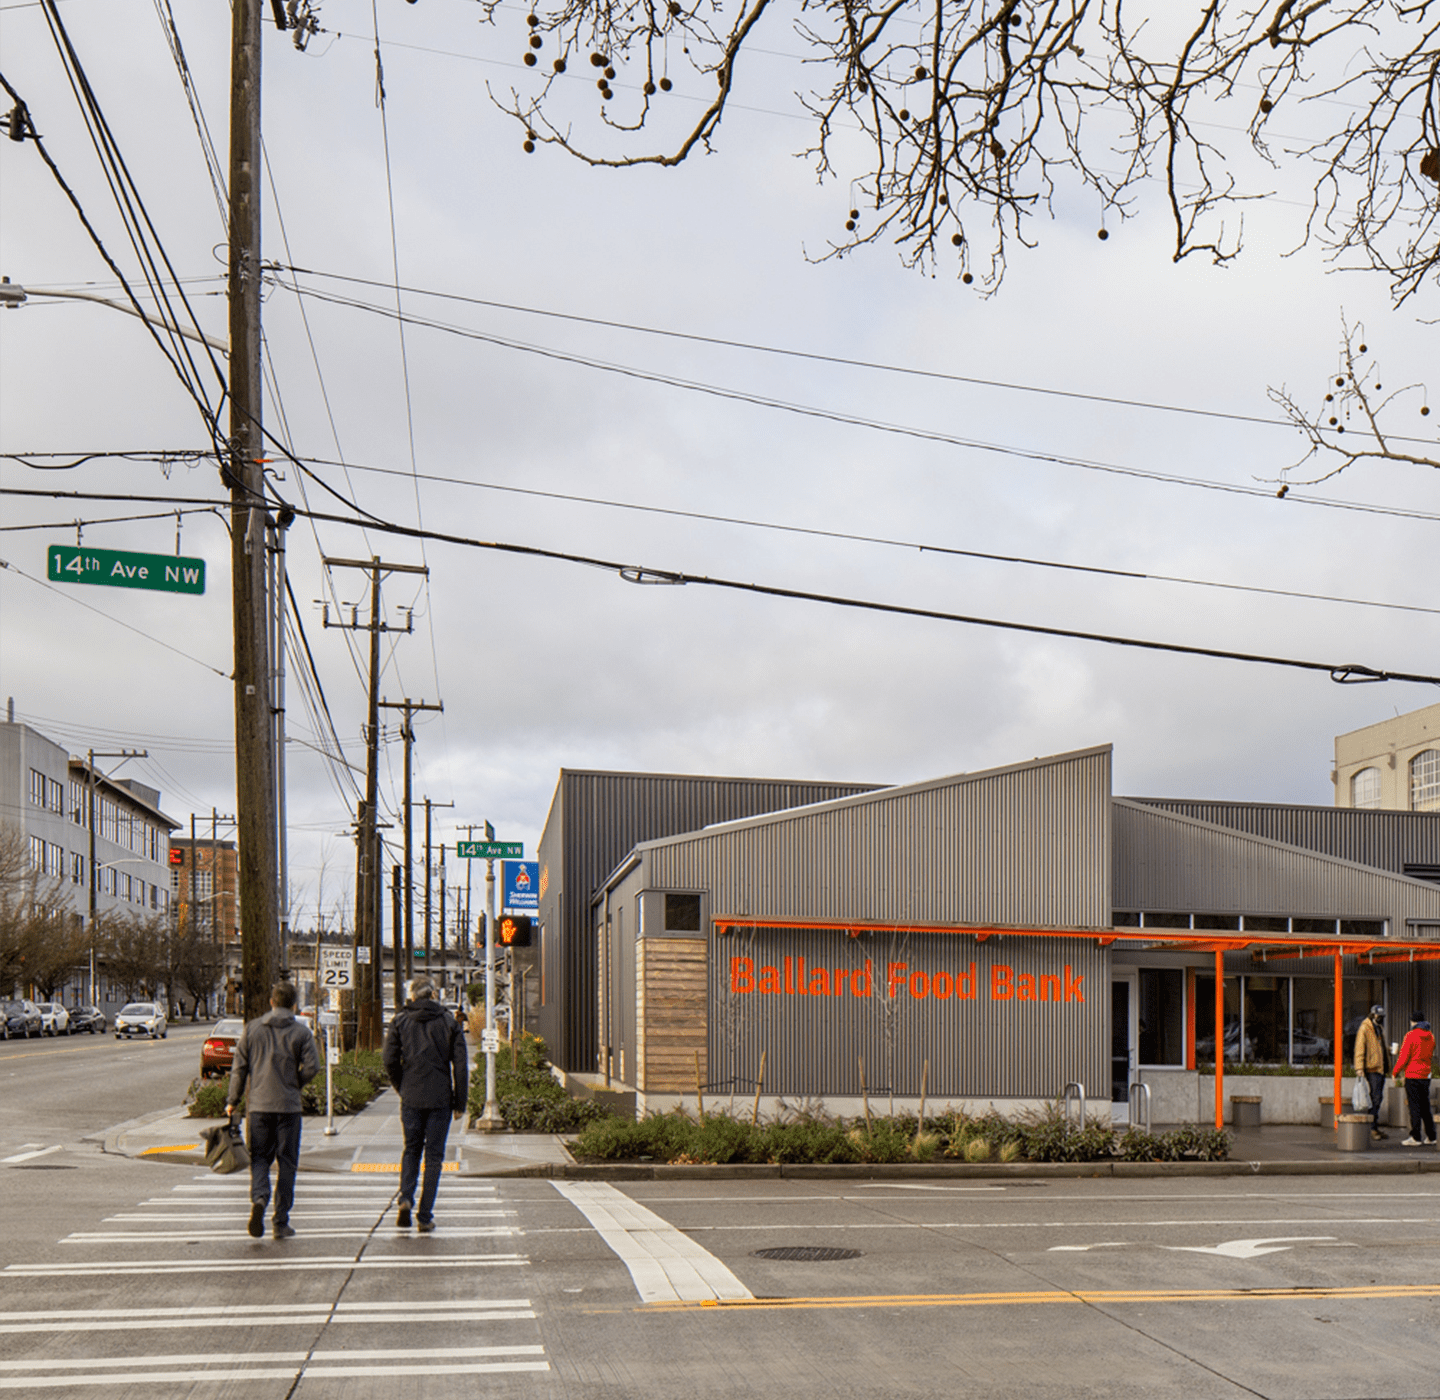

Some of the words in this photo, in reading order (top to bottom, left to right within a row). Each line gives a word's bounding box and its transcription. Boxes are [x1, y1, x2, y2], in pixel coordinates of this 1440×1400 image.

[54, 554, 100, 575] 14th
[111, 560, 149, 579] Ave
[165, 565, 200, 585] NW
[486, 845, 502, 855] Ave
[507, 846, 522, 855] NW
[322, 950, 352, 959] SPEED
[325, 960, 349, 968] LIMIT
[325, 969, 350, 986] 25
[731, 955, 872, 998] Ballard
[887, 962, 977, 1001] Food
[991, 964, 1086, 1003] Bank
